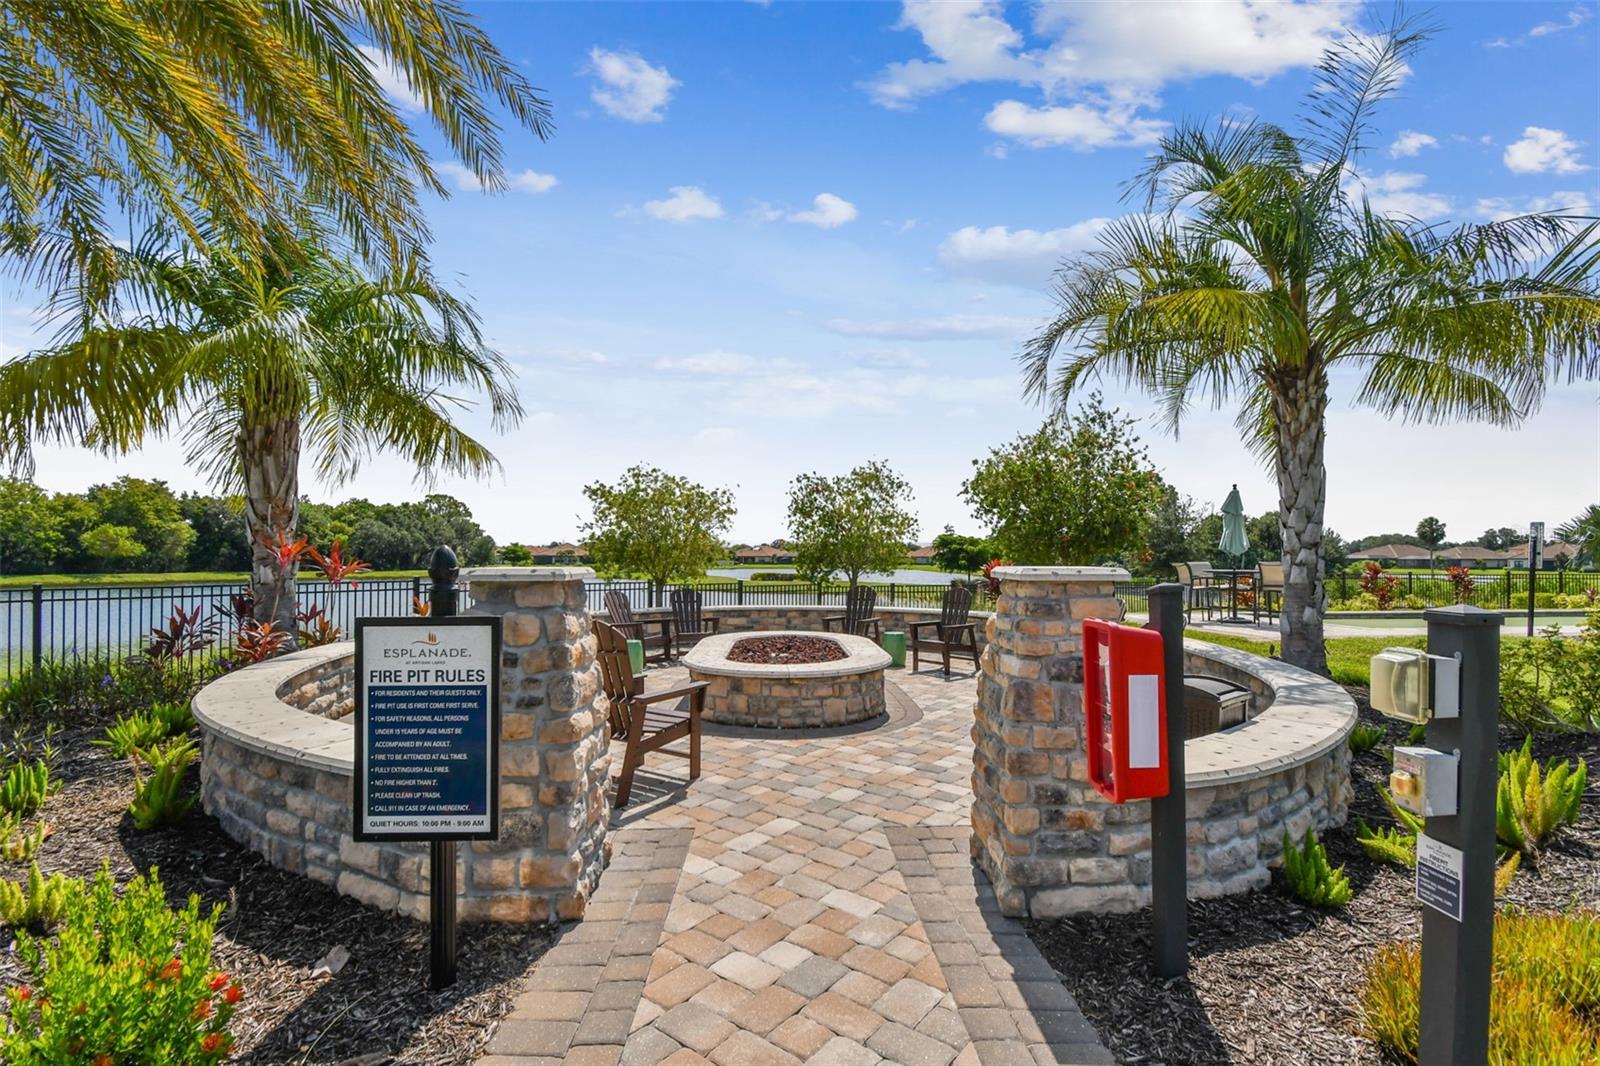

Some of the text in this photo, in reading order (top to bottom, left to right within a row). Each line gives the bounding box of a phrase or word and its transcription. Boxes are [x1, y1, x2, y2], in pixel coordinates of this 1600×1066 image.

[370, 670, 485, 682] FIRE PIT RULES
